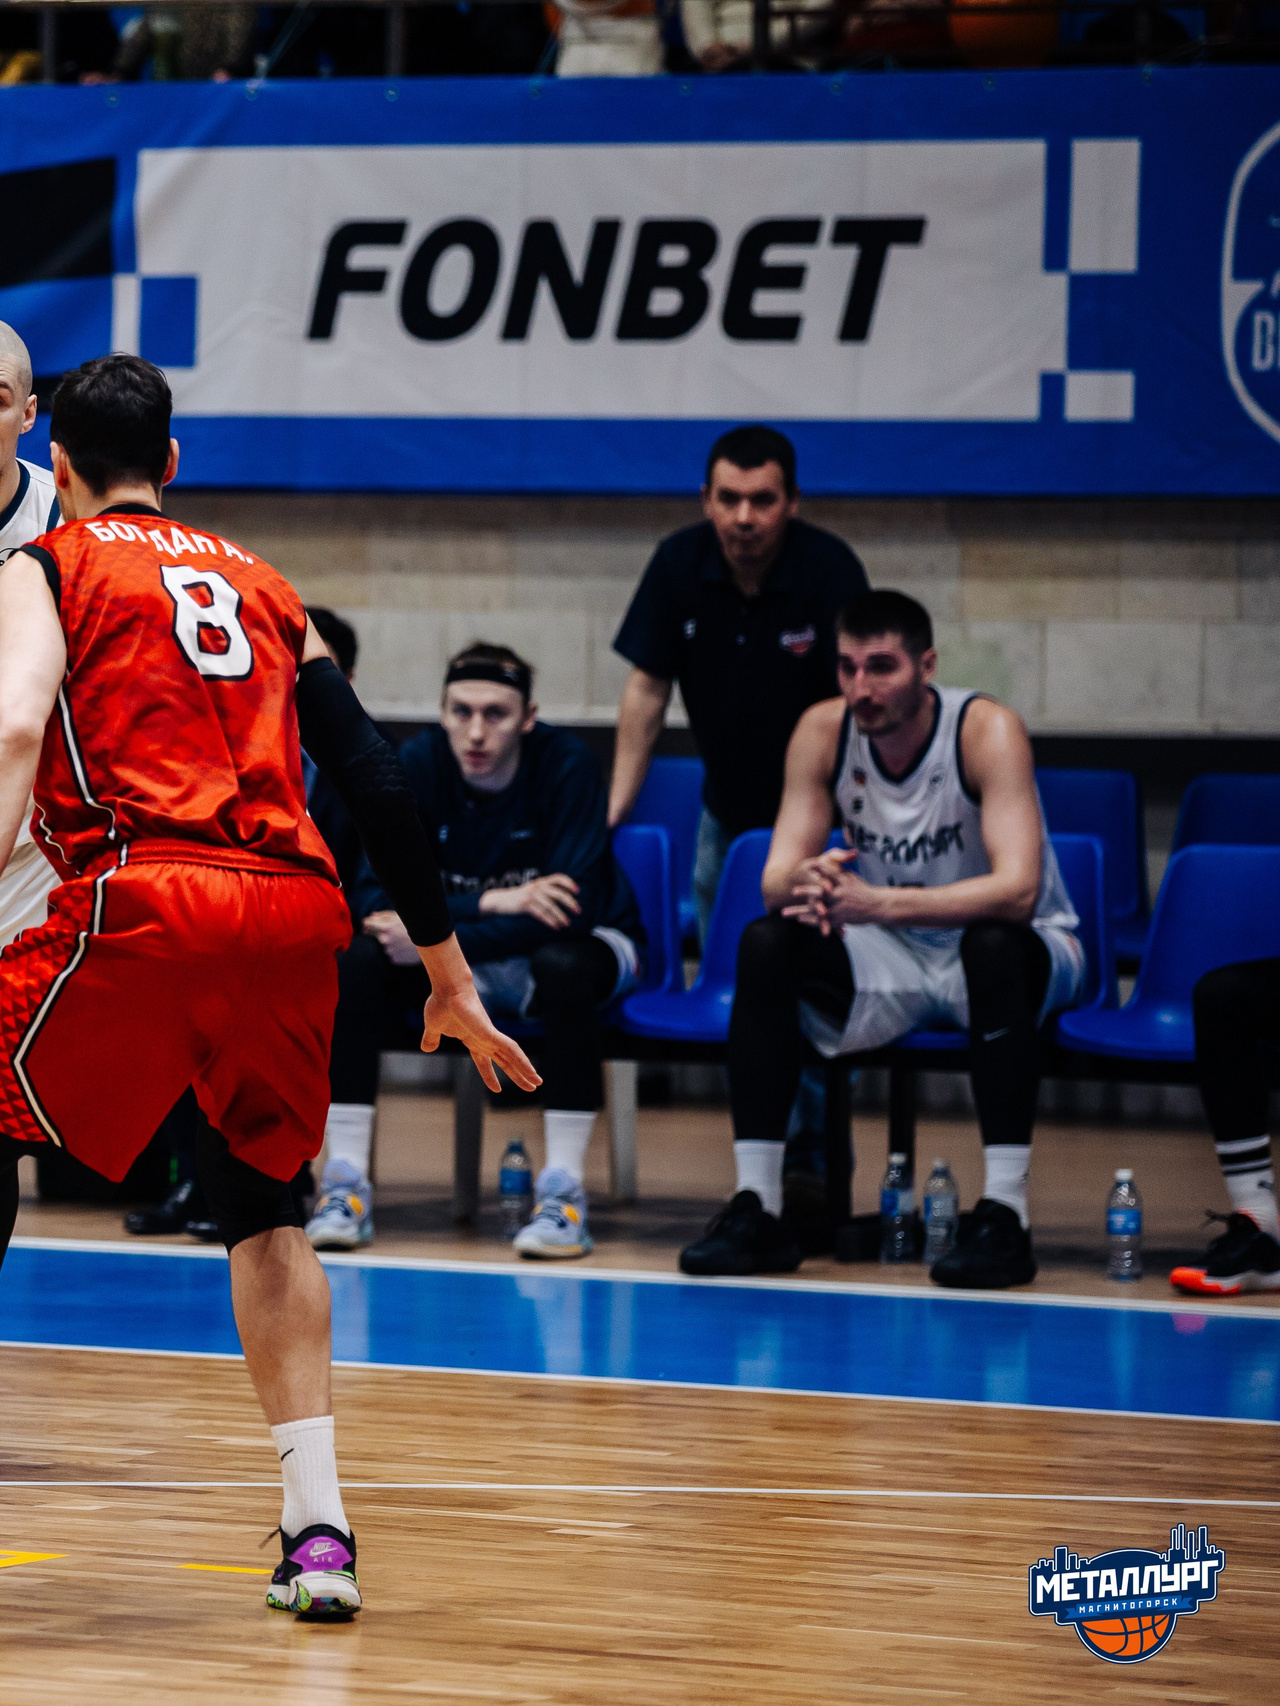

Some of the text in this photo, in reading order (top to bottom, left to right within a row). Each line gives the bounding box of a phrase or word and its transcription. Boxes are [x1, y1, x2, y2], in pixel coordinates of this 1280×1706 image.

[305, 214, 927, 344] FONBET
[159, 564, 254, 682] 8
[313, 1542, 332, 1552] NIKE
